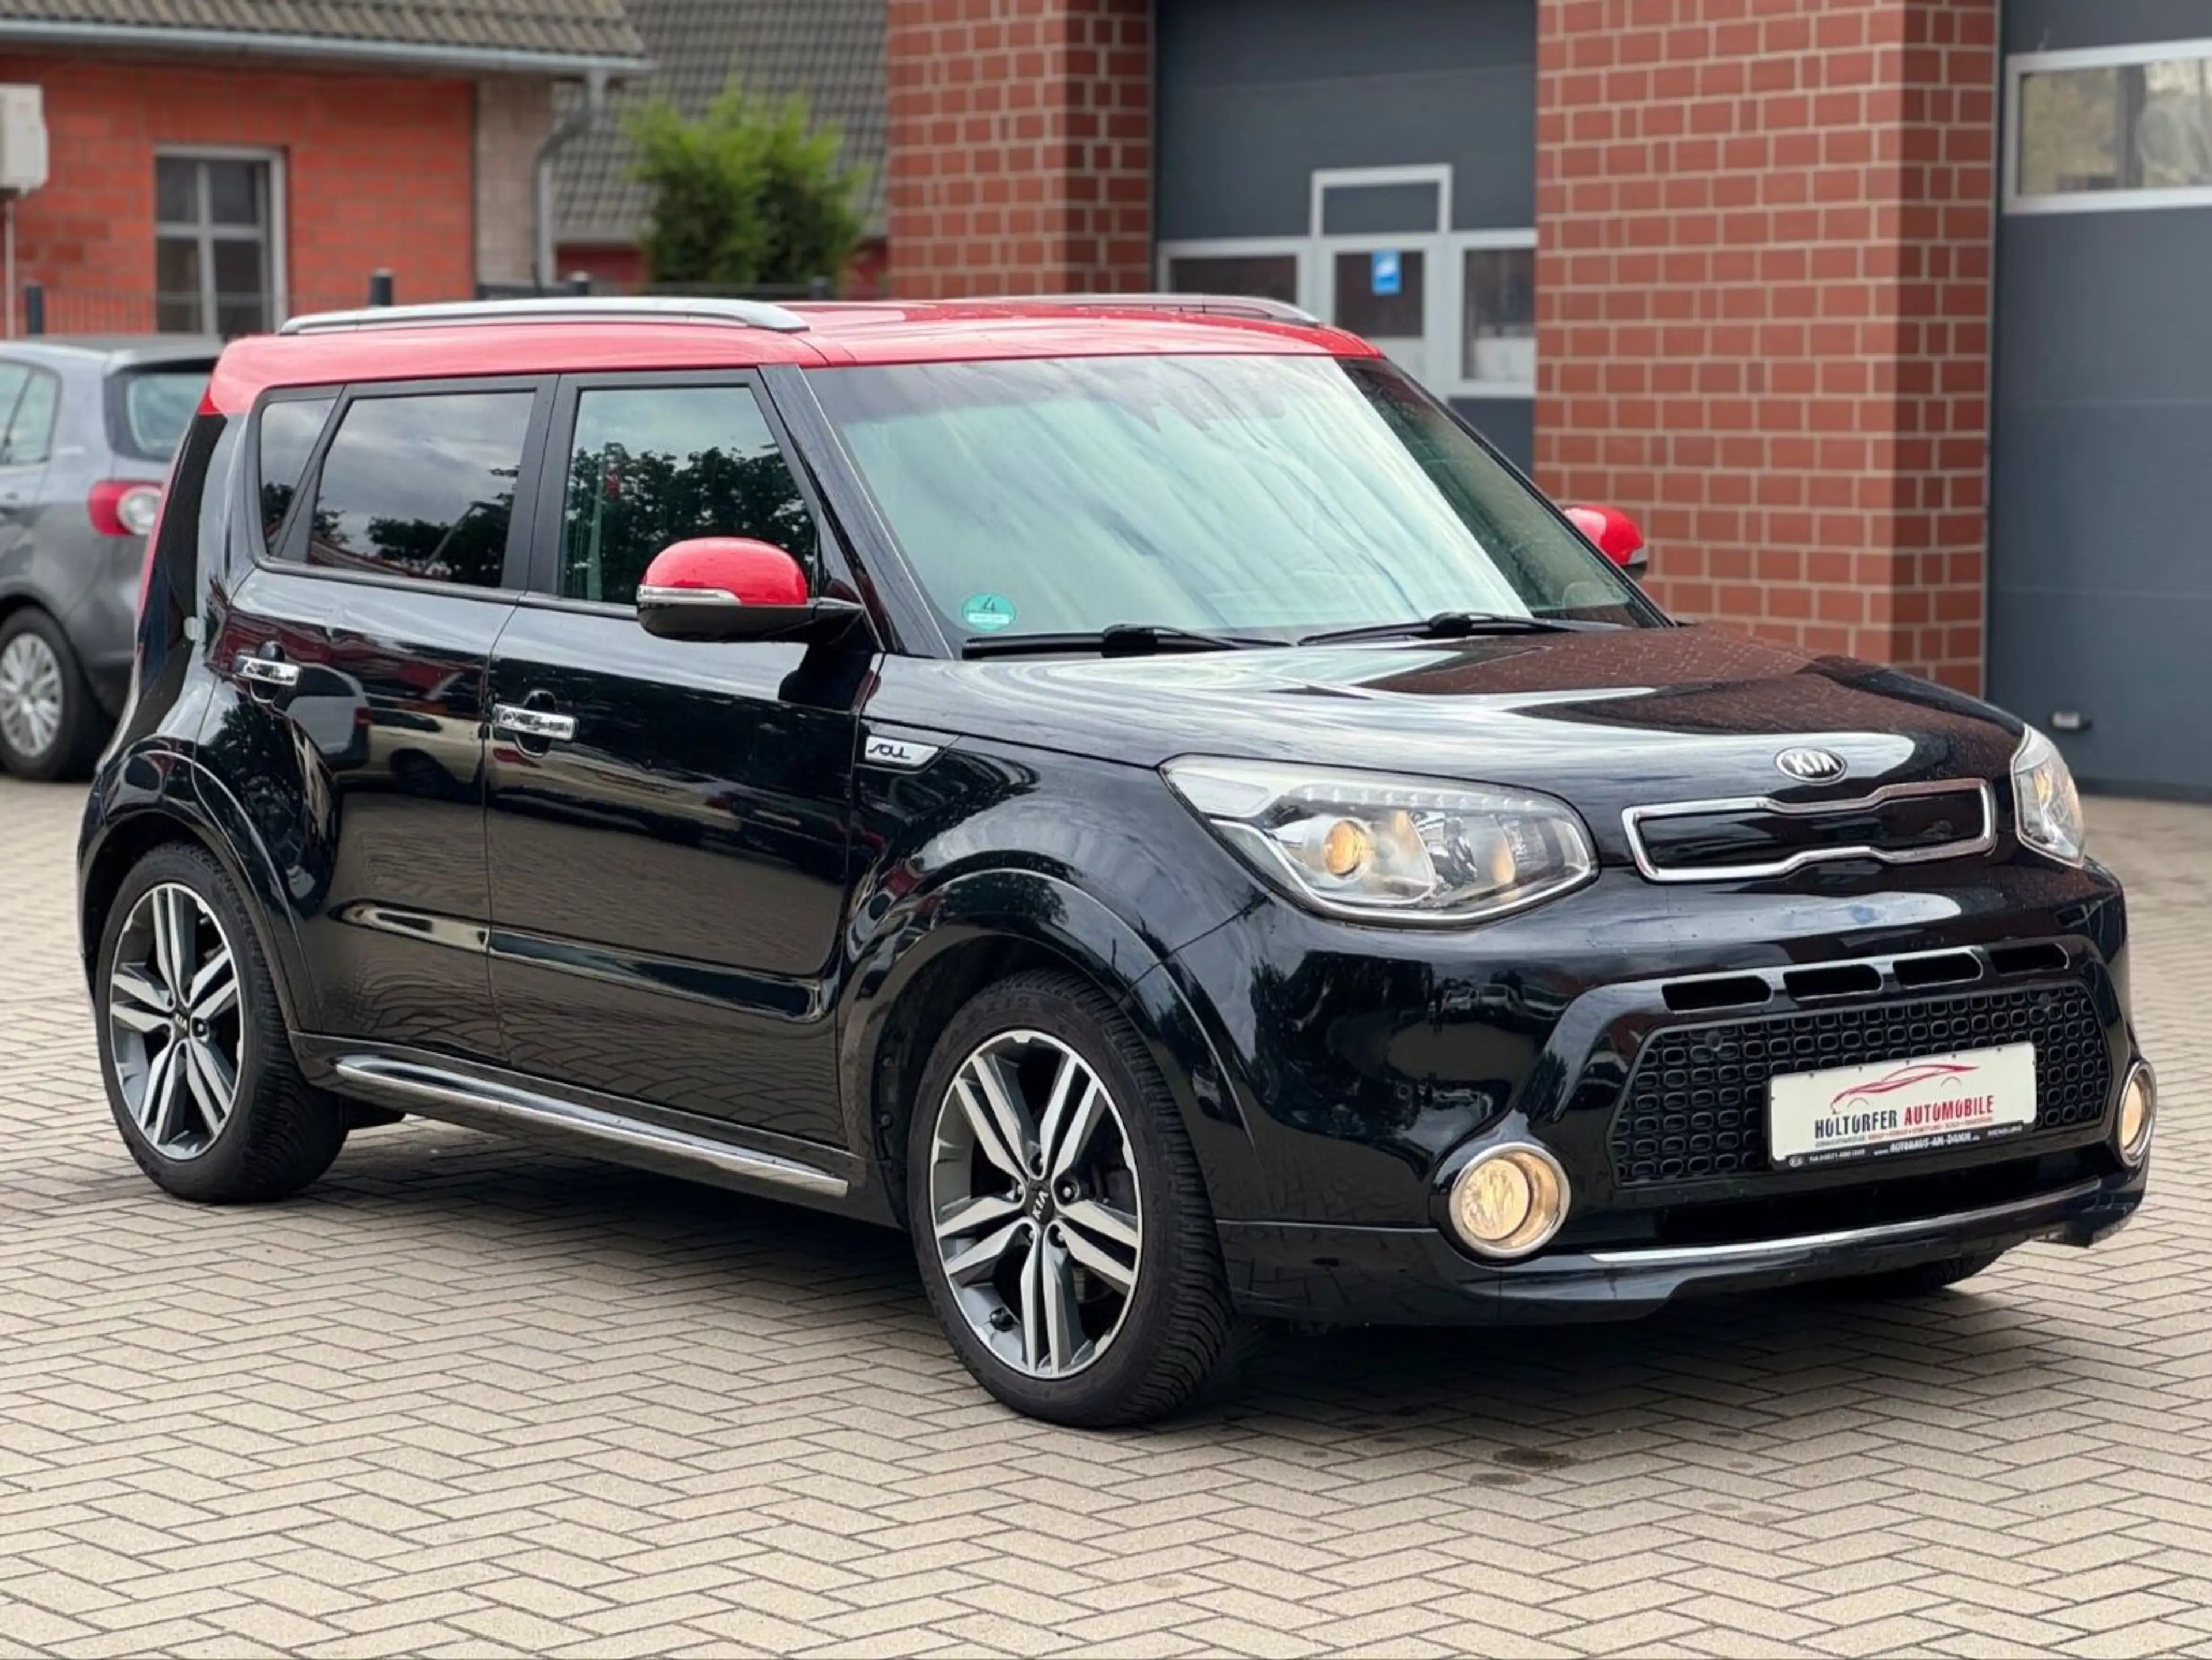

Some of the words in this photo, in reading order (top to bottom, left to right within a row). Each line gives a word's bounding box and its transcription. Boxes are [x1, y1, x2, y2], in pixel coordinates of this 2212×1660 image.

[1784, 751, 1840, 775] KIA
[1904, 1095, 1994, 1126] AUTOMOBILE
[1032, 1190, 1049, 1220] KIA
